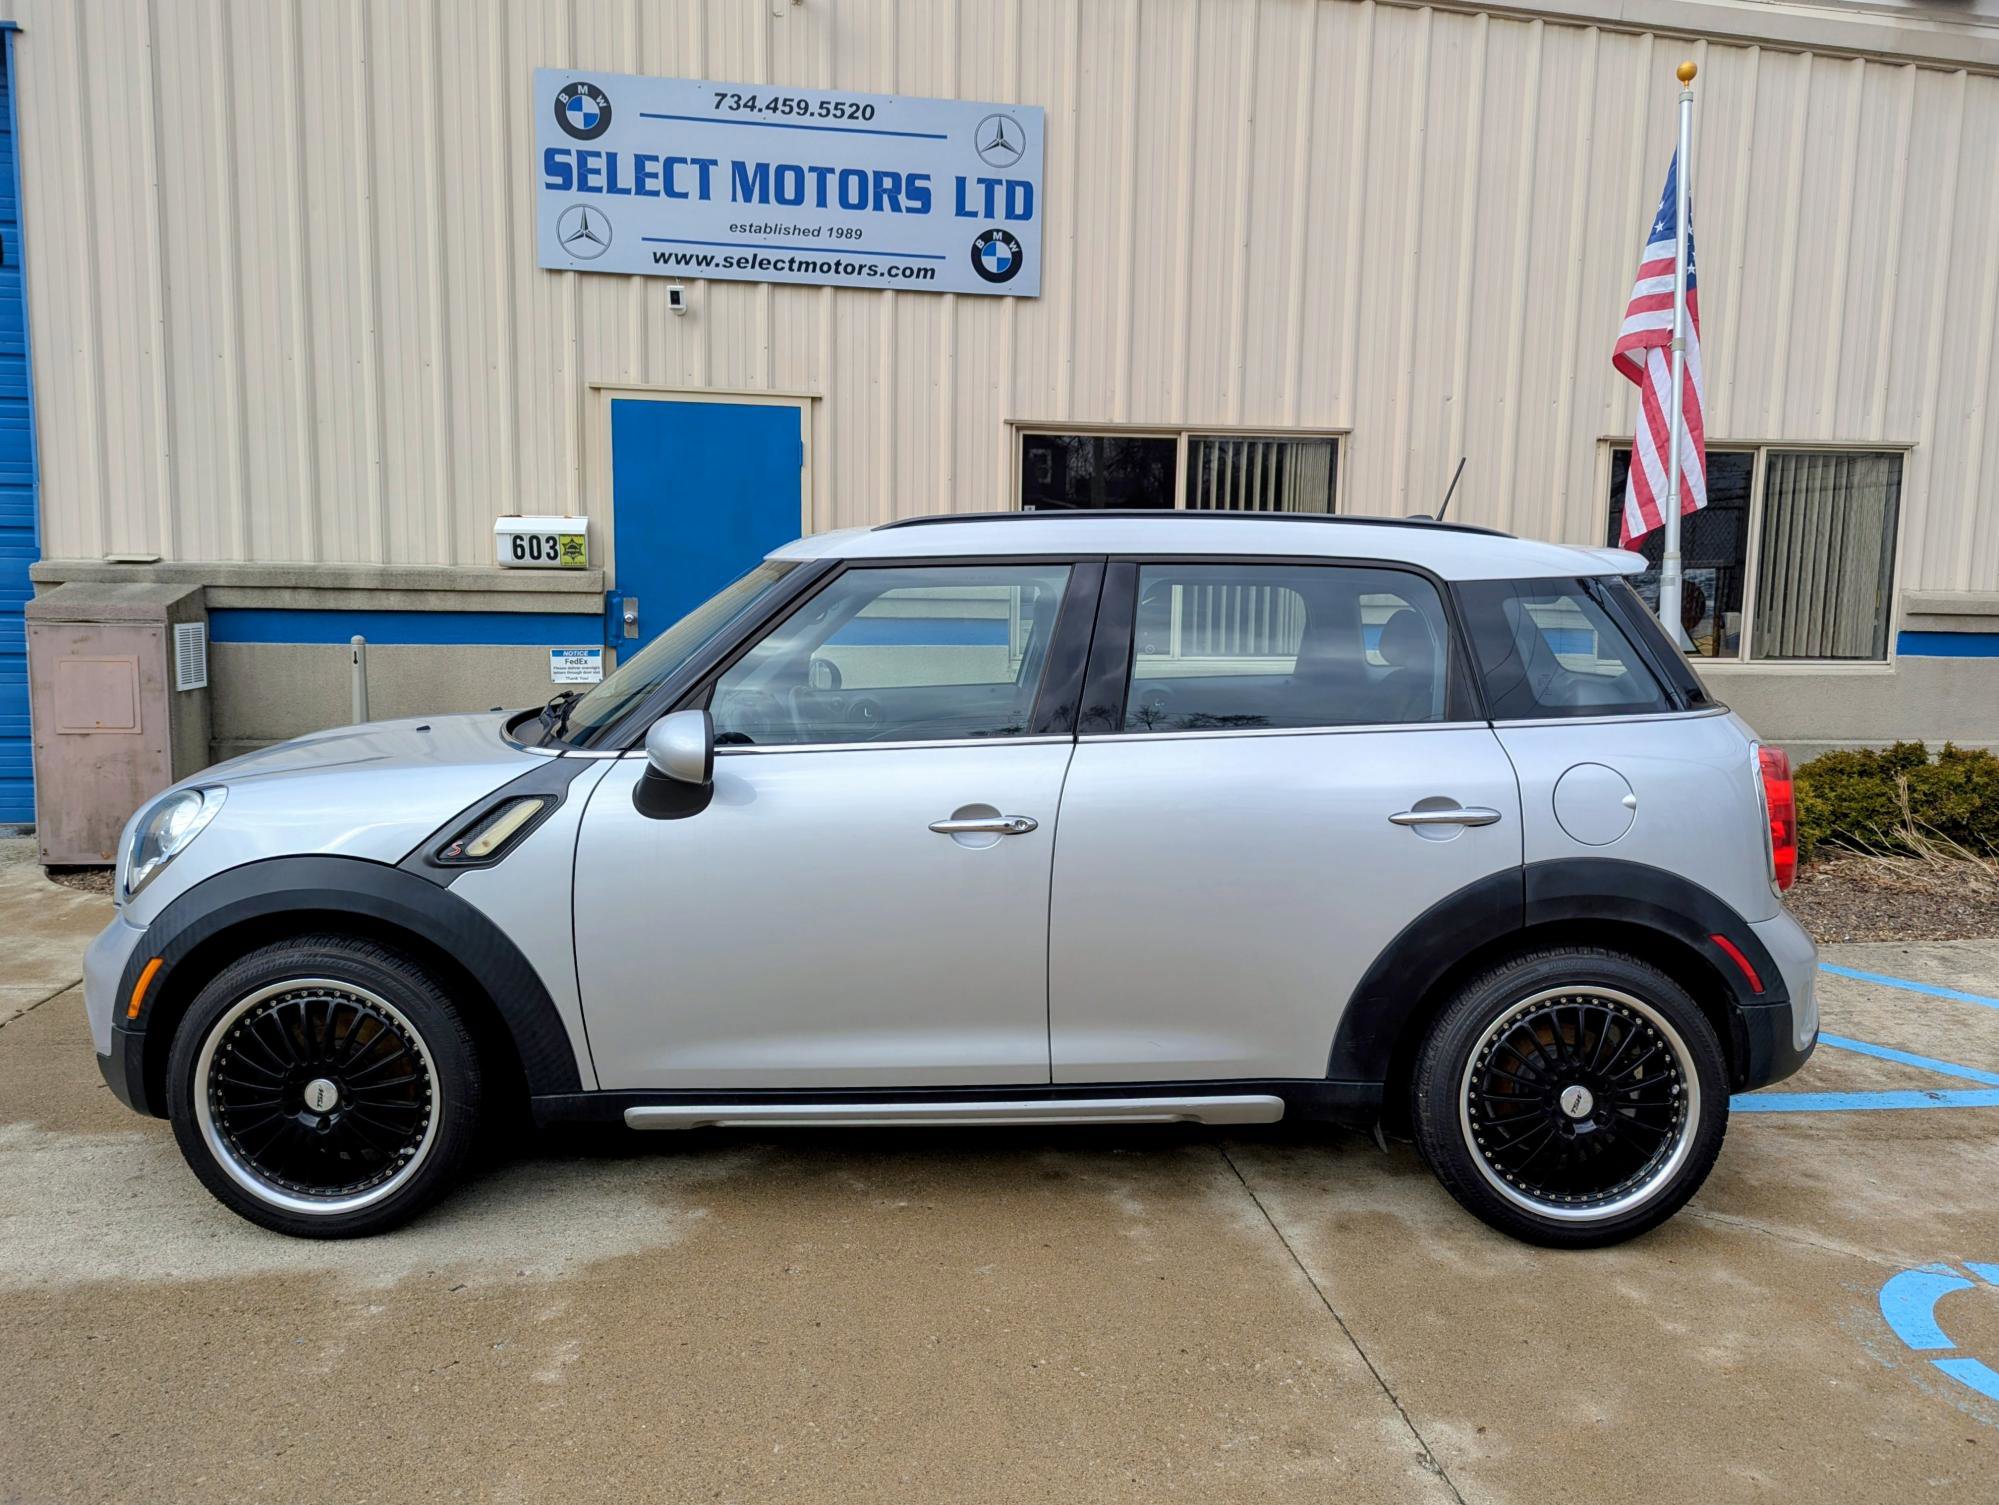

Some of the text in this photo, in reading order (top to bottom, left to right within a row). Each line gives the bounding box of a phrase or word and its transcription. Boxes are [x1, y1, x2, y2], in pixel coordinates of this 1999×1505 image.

[558, 84, 608, 108] BMW
[713, 92, 876, 121] 734.459.5520
[543, 147, 1034, 222] SELECT MOTORS LTD
[729, 223, 864, 241] established 1989
[975, 231, 1020, 253] BMW
[651, 250, 937, 281] www.selectmotors.com
[512, 534, 559, 561] 603
[447, 840, 463, 857] S
